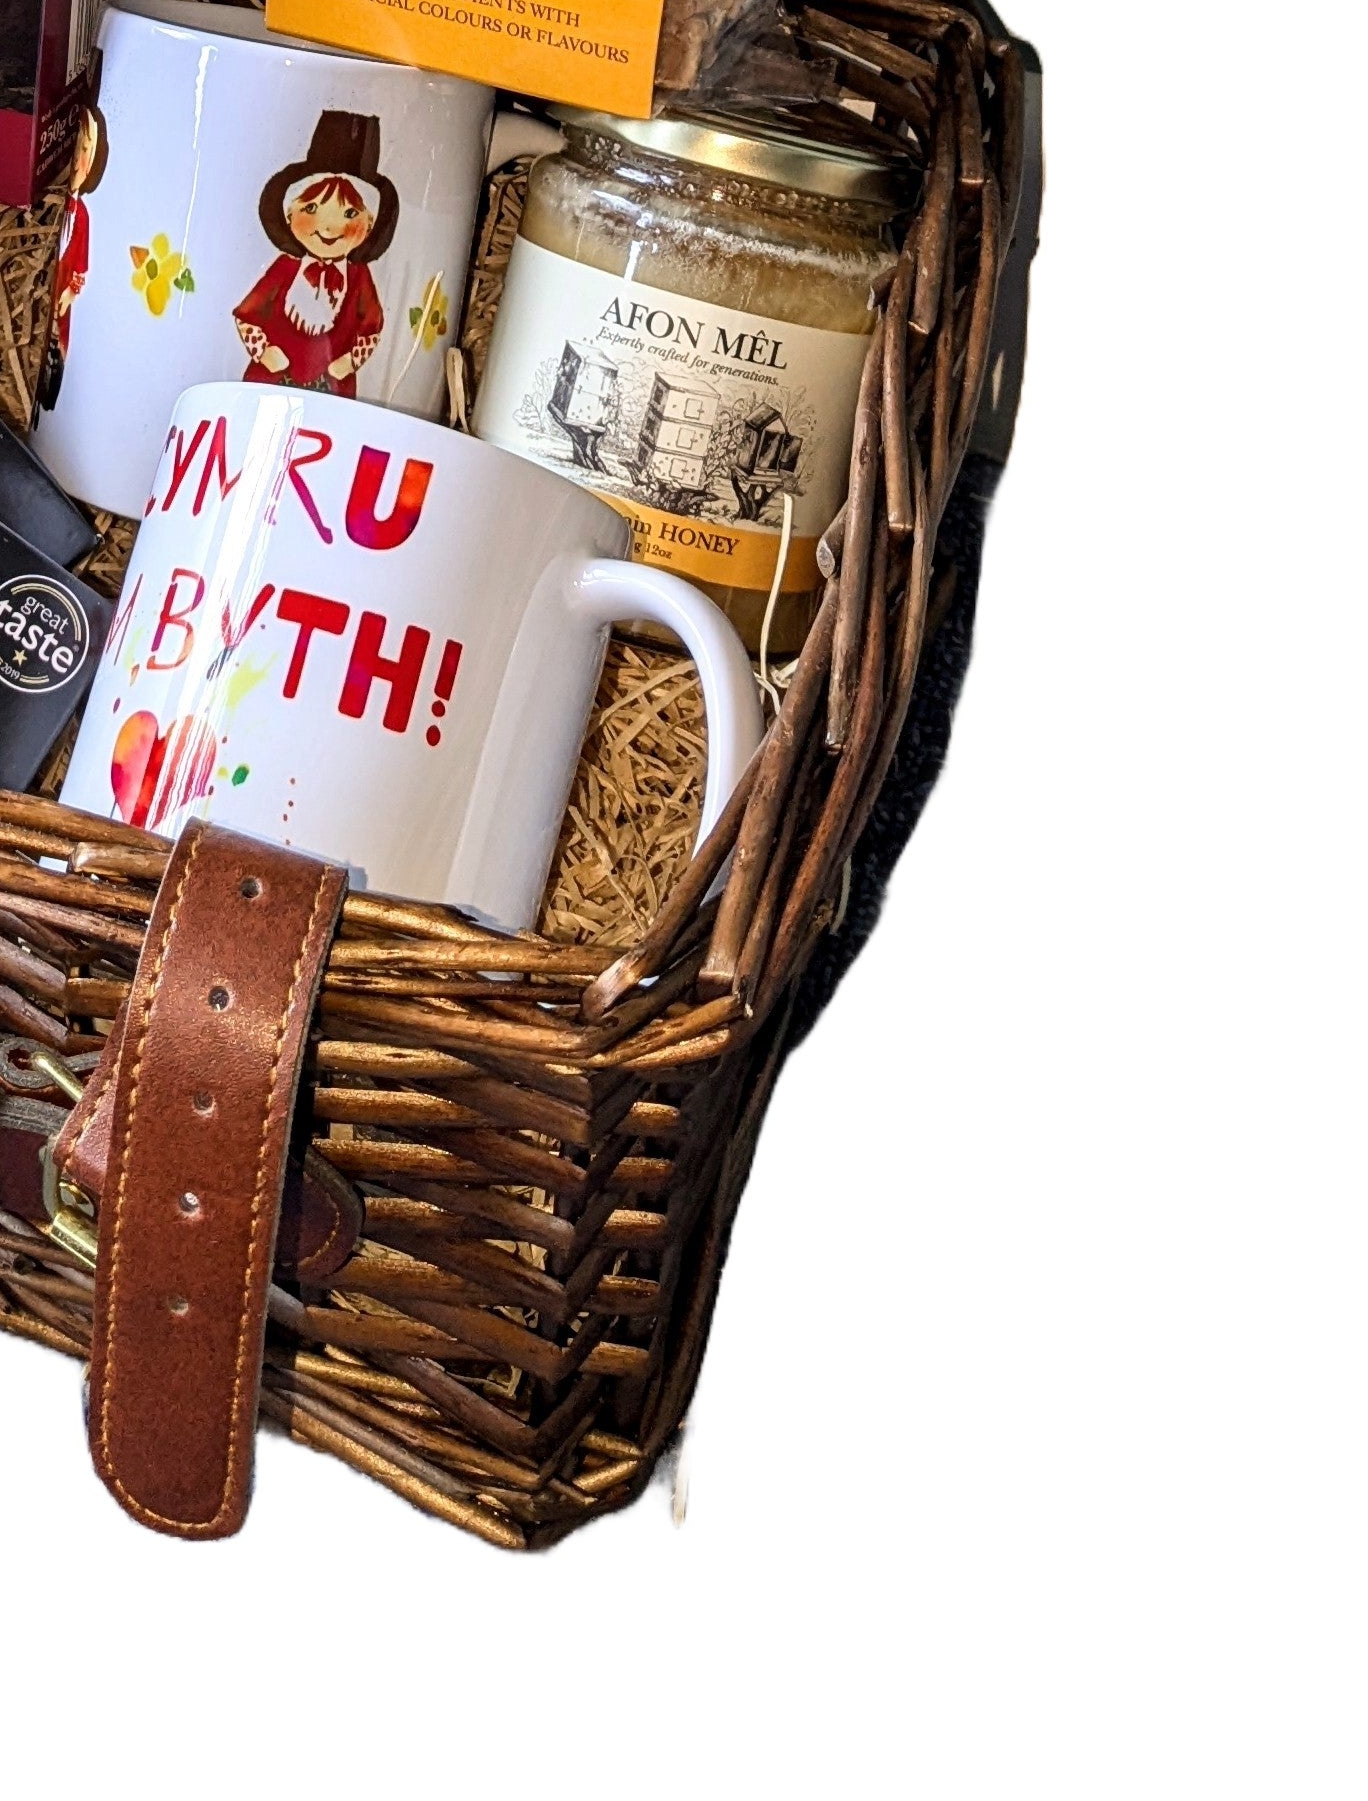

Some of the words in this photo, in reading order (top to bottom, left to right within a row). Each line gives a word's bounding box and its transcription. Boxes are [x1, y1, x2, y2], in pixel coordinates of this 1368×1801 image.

[419, 0, 503, 33] COLOURS
[506, 22, 532, 42] OR
[536, 29, 629, 64] FLAVOURS
[529, 2, 580, 28] WITH
[599, 296, 706, 349] AFON
[711, 326, 788, 370] MÊL
[596, 326, 645, 352] Expertly
[647, 343, 688, 363] crafted
[688, 355, 709, 370] for
[710, 362, 779, 386] generations.
[645, 542, 672, 560] 12oz
[658, 522, 740, 556] HONEY
[20, 596, 69, 635] great
[0, 662, 20, 680] 2019
